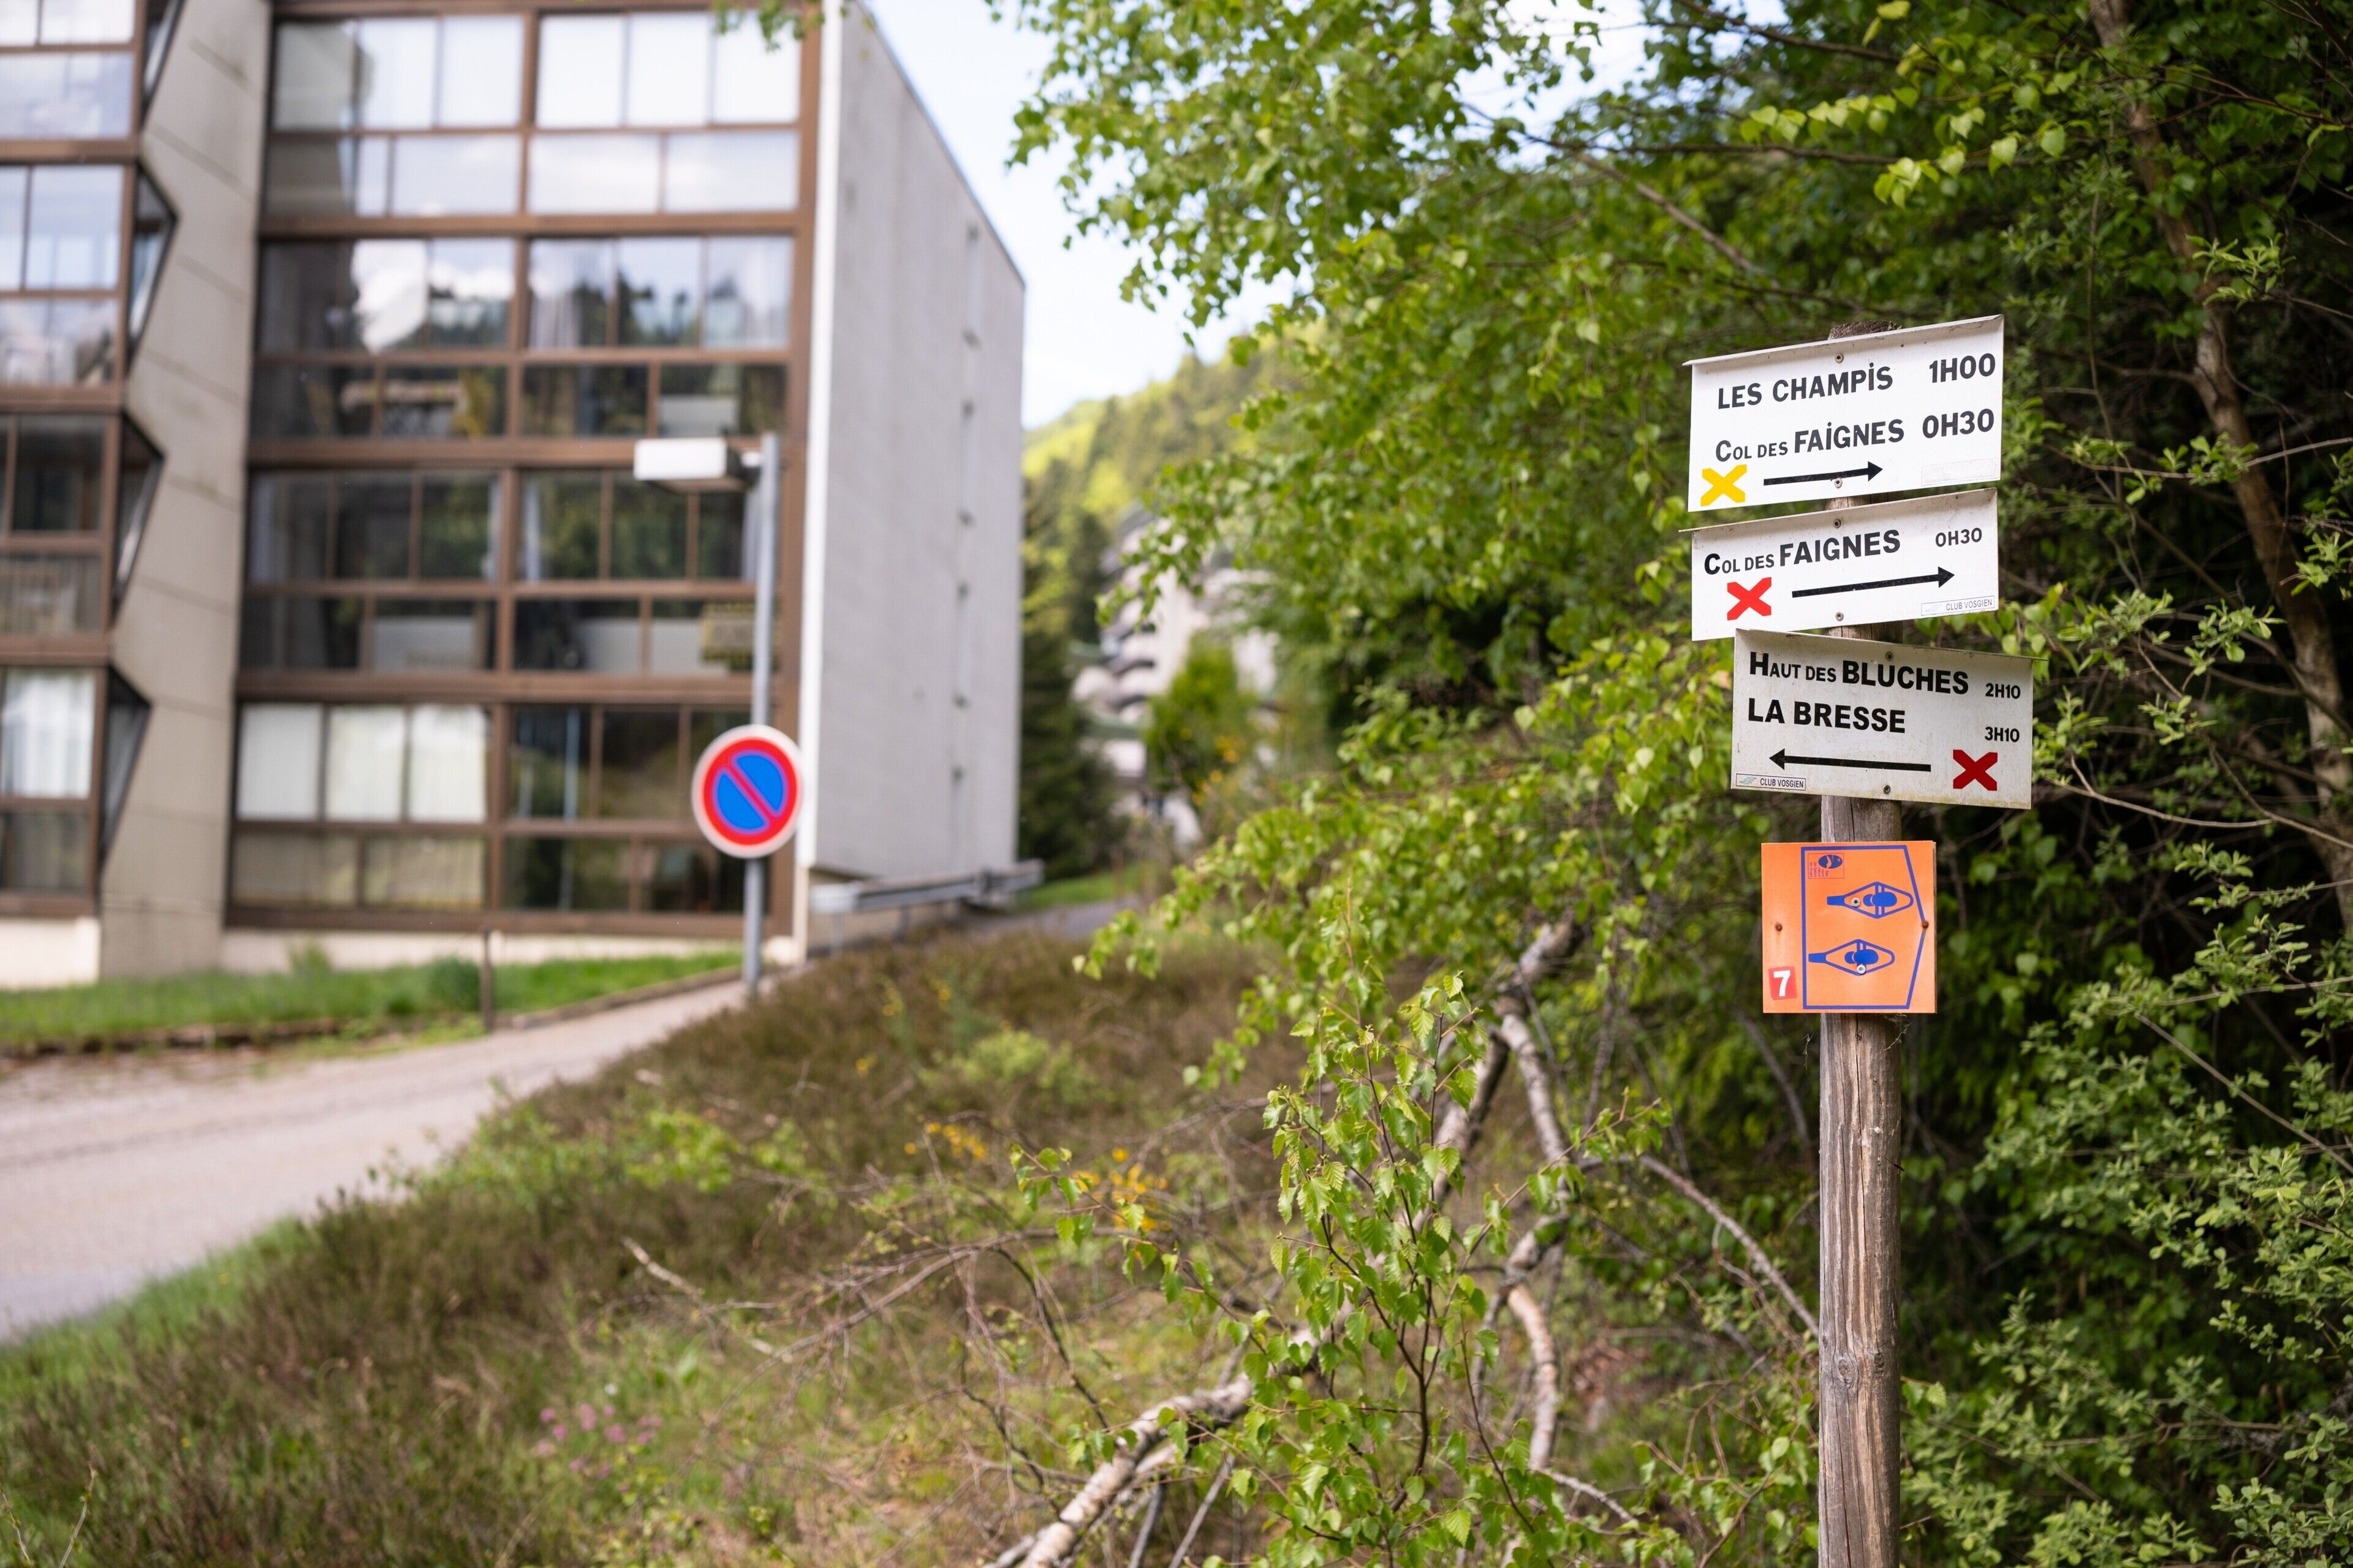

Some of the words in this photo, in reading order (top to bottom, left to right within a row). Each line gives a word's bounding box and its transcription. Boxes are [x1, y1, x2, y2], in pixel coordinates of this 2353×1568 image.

[1718, 382, 1762, 409] LES
[1929, 353, 1996, 383] 1H00
[1922, 408, 1994, 439] 0H30
[1780, 529, 1900, 567] FAIGNES
[1935, 527, 1982, 547] 0H30
[1946, 602, 1963, 611] CLUB
[1964, 599, 1992, 608] VOSGIEN
[1842, 660, 1969, 695] BLUCHES
[1985, 683, 2021, 700] 2H10
[1748, 697, 1785, 724] LA
[1794, 701, 1905, 733] BRESSE
[1984, 726, 2021, 743] 3H10
[1760, 778, 1776, 786] CLUB
[1777, 779, 1804, 788] VOSGIEN
[1773, 970, 1790, 997] 7
